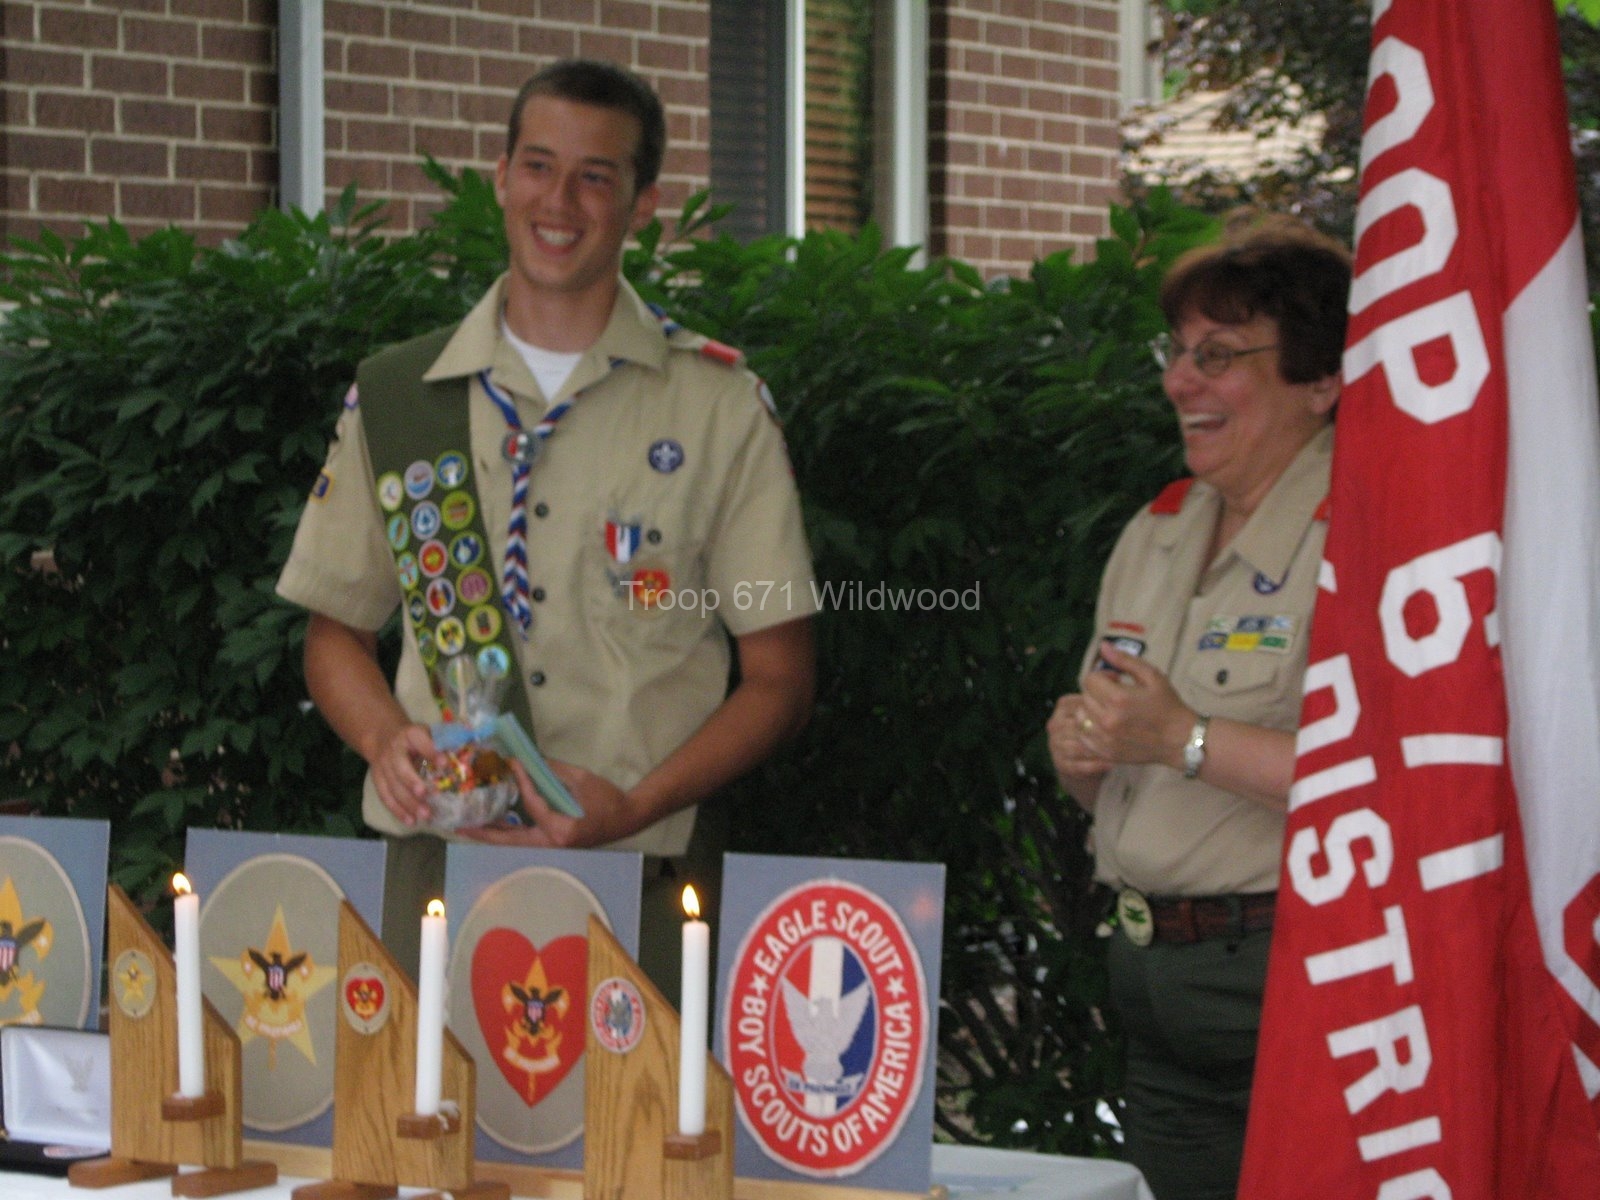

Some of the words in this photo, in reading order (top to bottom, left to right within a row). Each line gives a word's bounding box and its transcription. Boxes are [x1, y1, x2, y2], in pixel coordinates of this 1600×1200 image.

[1343, 0, 1491, 425] OOP
[753, 899, 827, 976] EAGLE
[831, 901, 904, 975] SCOUT
[738, 996, 768, 1058] BOY
[858, 1000, 912, 1133] AMERICA
[743, 1062, 829, 1157] SCOUTS
[831, 1121, 864, 1154] OF
